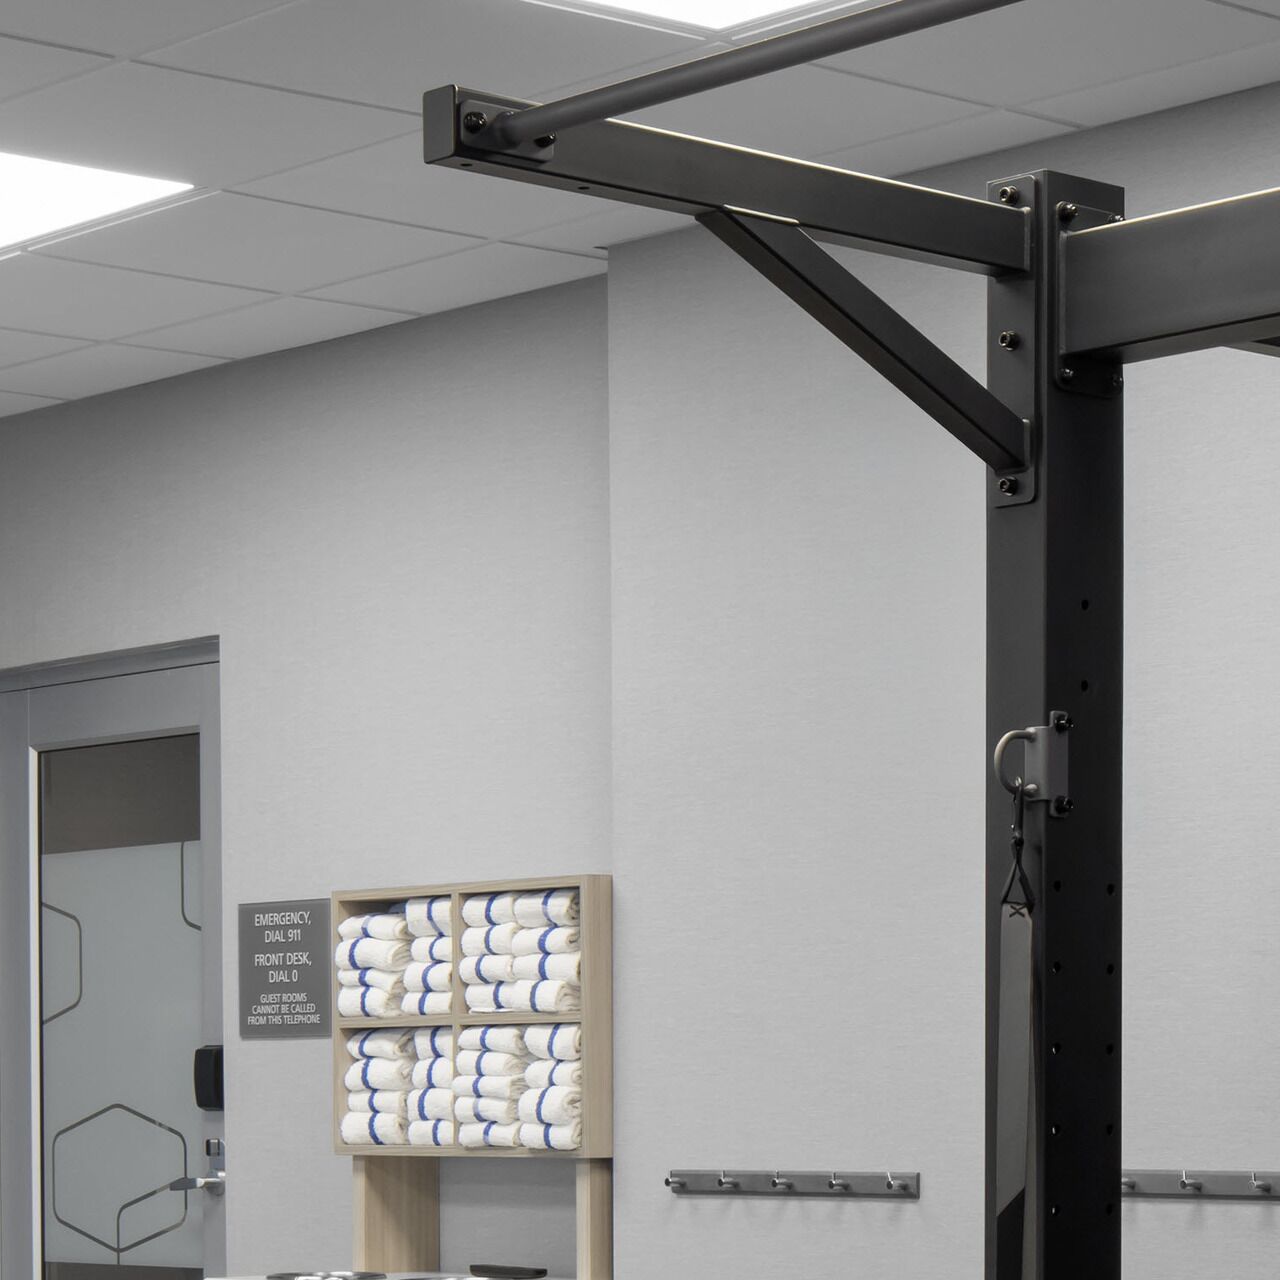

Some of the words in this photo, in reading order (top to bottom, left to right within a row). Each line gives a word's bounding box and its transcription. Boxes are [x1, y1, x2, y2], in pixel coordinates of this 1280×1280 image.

[254, 911, 312, 927] EMERGENCY,
[265, 930, 286, 943] DIAL
[288, 929, 301, 942] 911
[254, 953, 284, 966] FRONT
[286, 952, 312, 966] DESK,
[269, 970, 290, 983] DIAL
[292, 970, 298, 982] 0
[260, 993, 281, 1003] GUEST
[282, 993, 307, 1002] ROOMS
[252, 1004, 280, 1014] CANNOT
[281, 1004, 289, 1013] BE
[290, 1003, 316, 1013] CALLED
[248, 1015, 266, 1025] FROM
[268, 1015, 282, 1025] THIS
[284, 1014, 320, 1024] TELEPHONE
